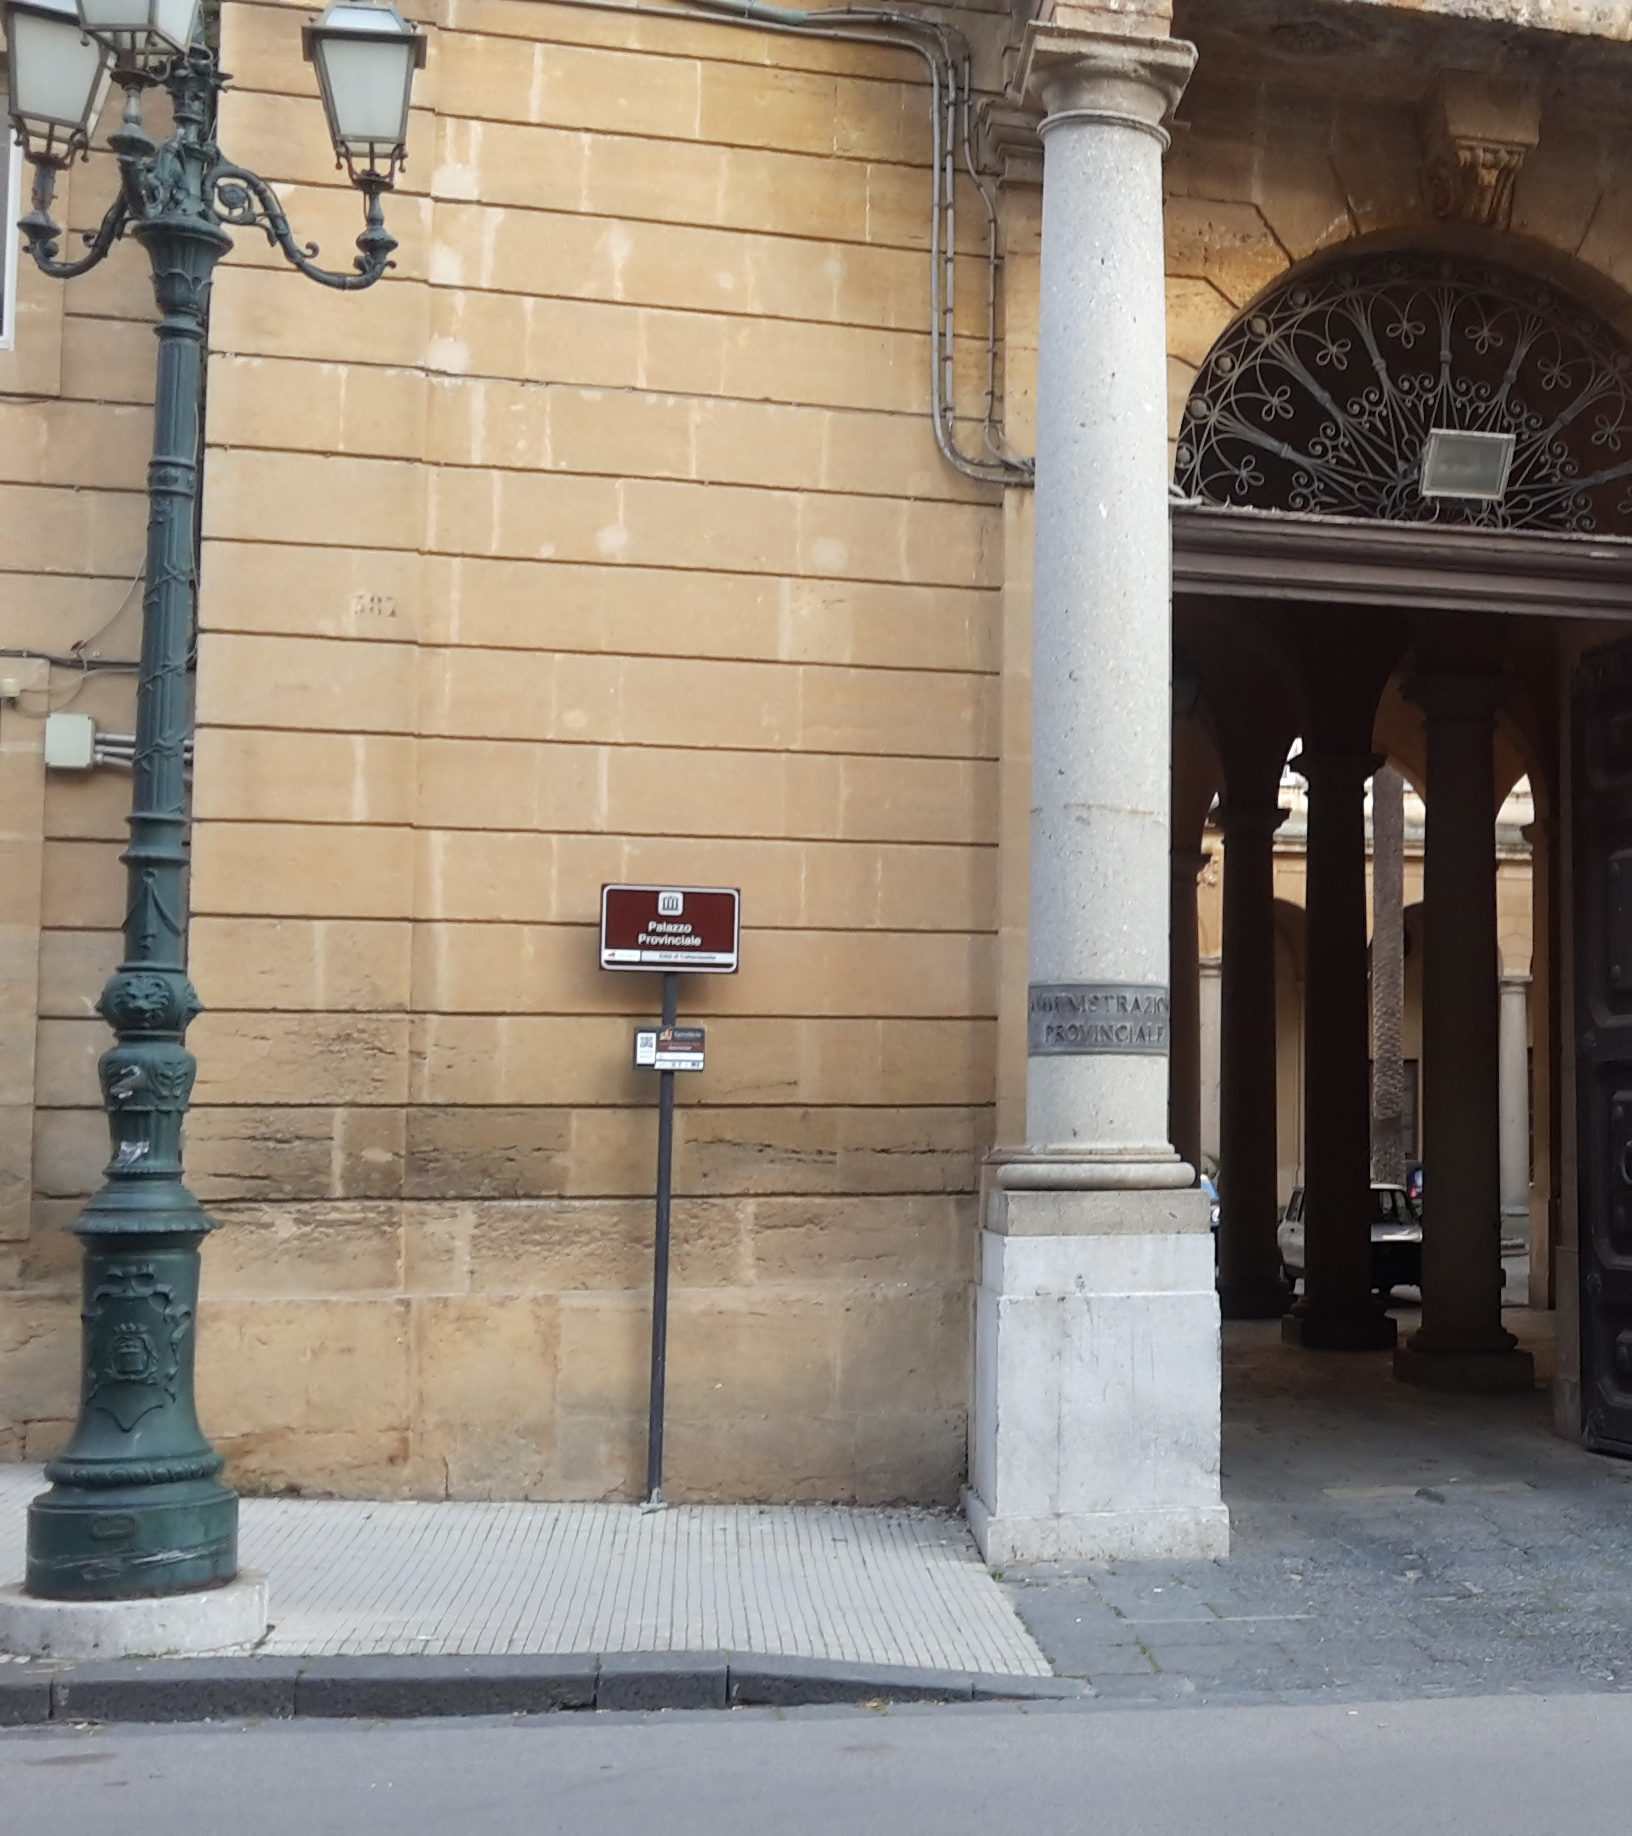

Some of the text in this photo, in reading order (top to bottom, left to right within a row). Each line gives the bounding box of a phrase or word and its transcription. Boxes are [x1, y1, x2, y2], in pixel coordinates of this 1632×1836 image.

[648, 920, 693, 934] Palazzo
[638, 933, 702, 947] Provinciale
[1044, 1023, 1165, 1044] PROVINCIALE
